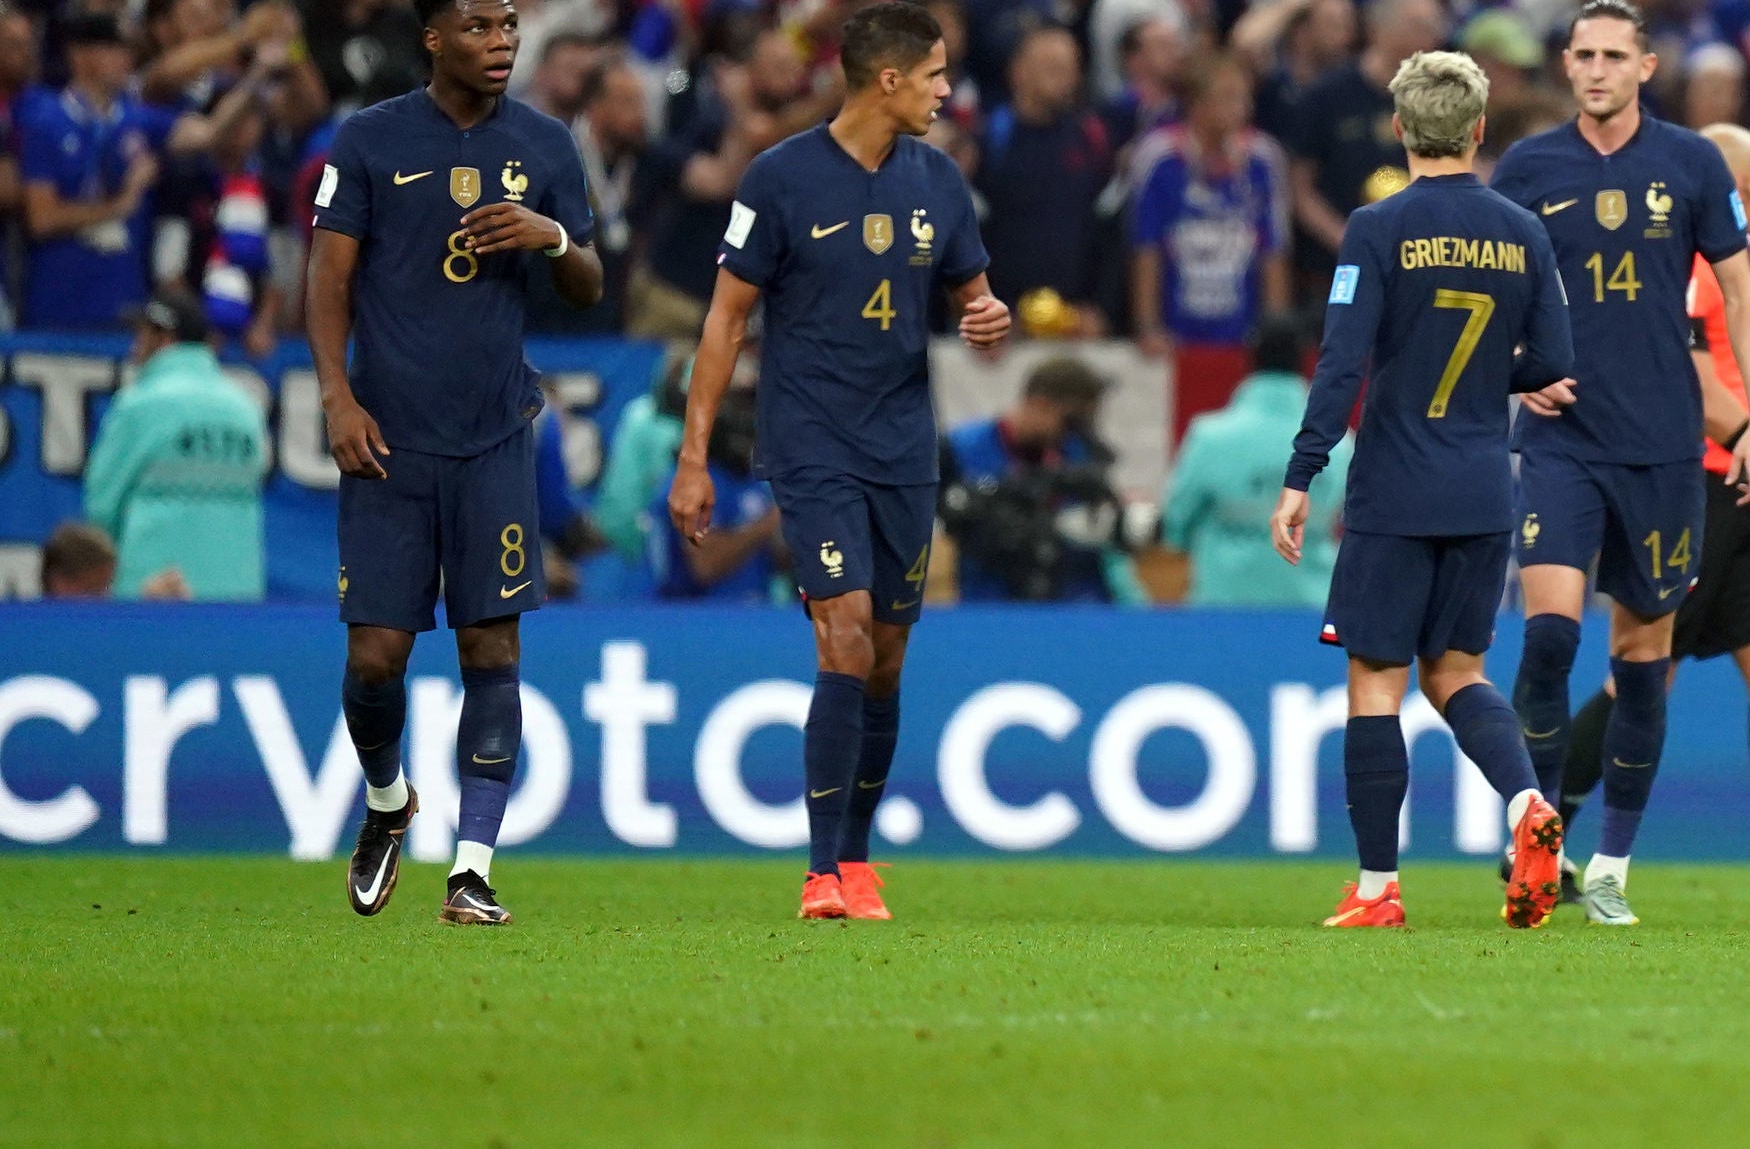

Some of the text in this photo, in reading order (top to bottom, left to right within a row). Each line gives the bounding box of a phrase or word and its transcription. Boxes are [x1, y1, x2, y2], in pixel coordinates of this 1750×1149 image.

[443, 229, 478, 283] 8
[1400, 237, 1526, 274] GRIEZMANN
[1585, 251, 1643, 302] 14
[861, 279, 897, 331] 4
[1427, 288, 1496, 418] 7
[500, 523, 525, 576] 8
[904, 544, 929, 592] 4
[1643, 527, 1692, 579] 14
